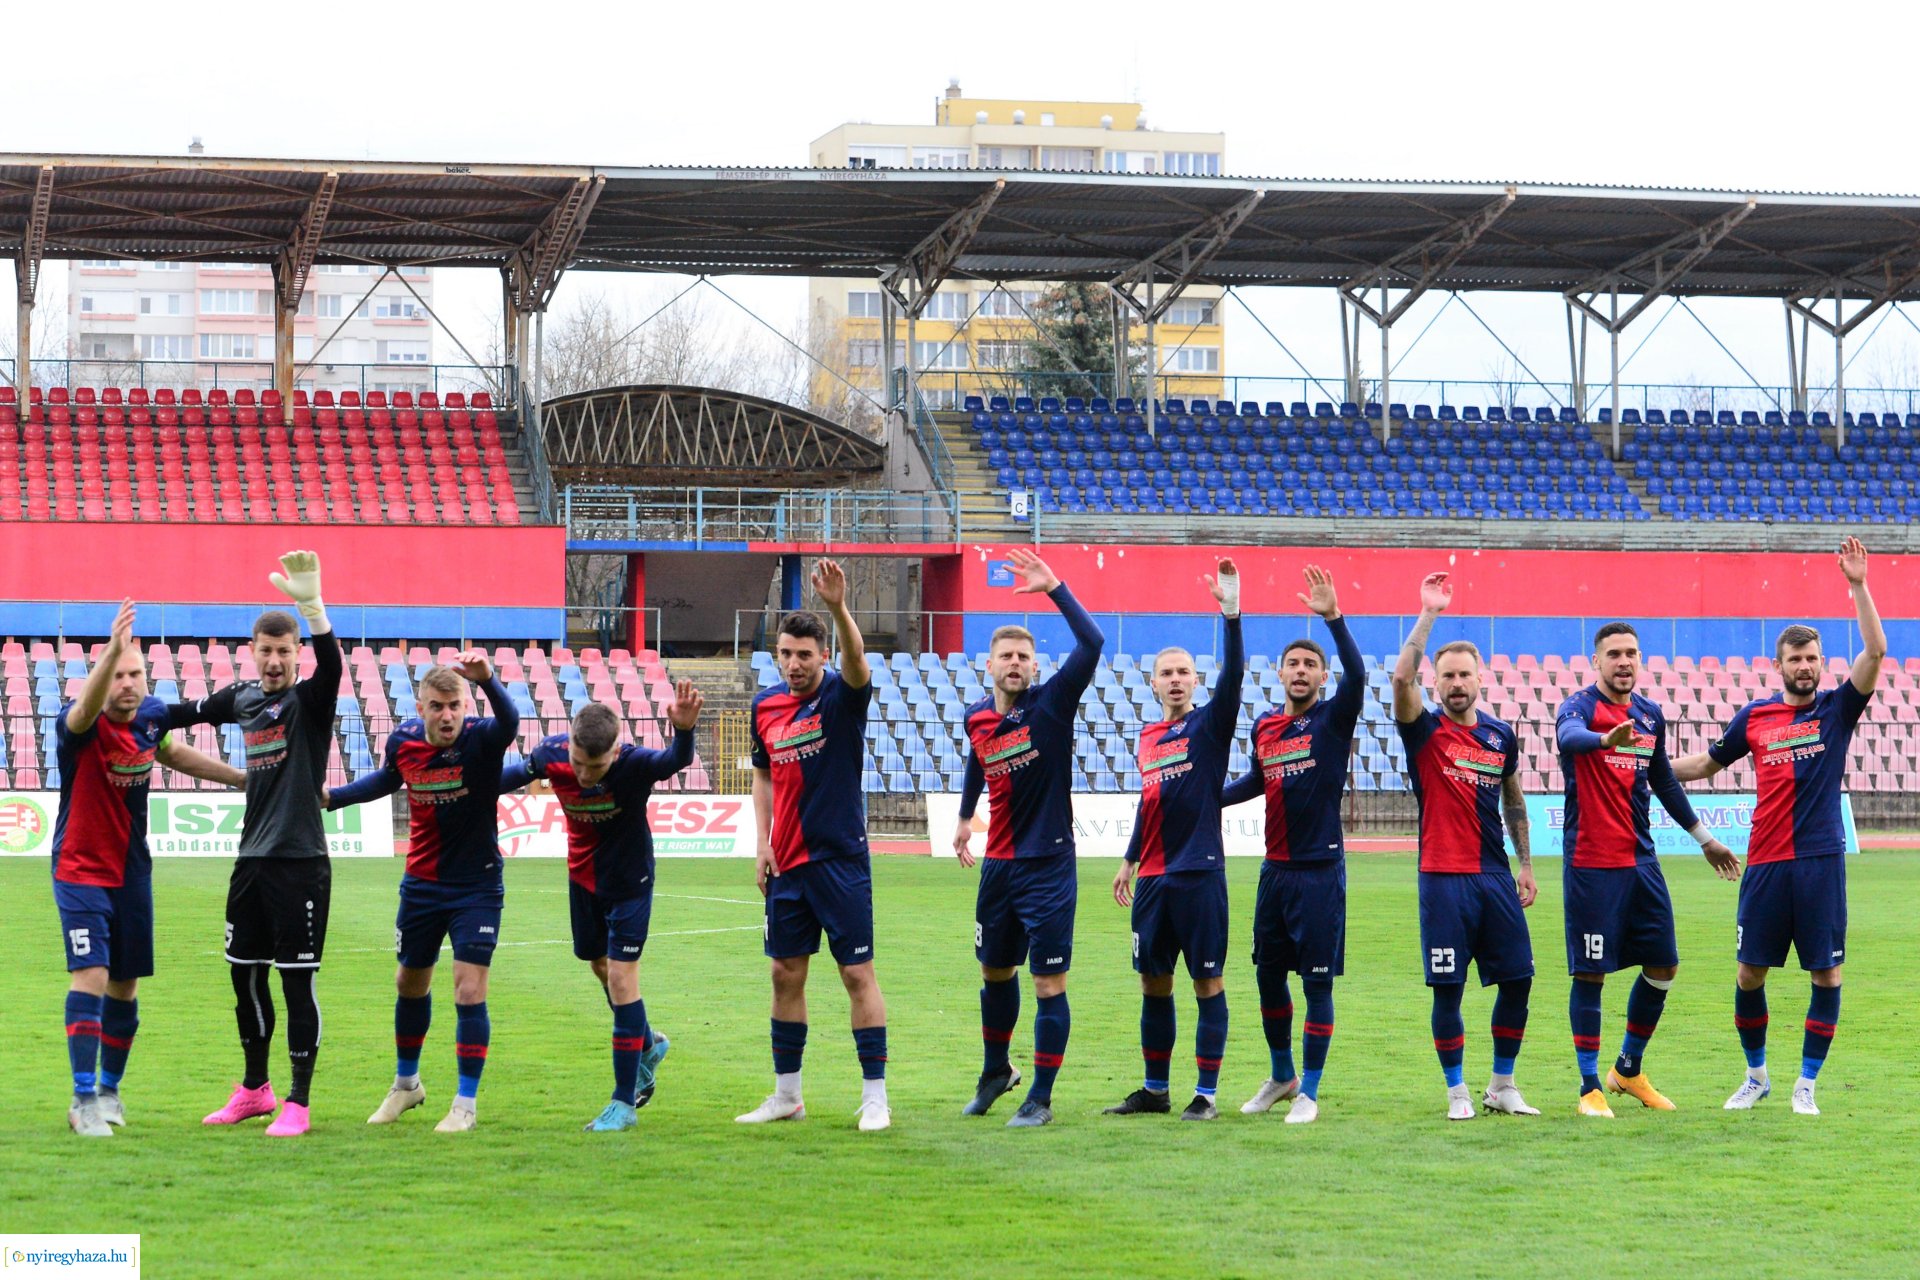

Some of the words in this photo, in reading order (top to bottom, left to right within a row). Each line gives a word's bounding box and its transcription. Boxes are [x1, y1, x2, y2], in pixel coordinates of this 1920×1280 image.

[820, 170, 888, 181] NYÍREGYHÁZA
[1015, 502, 1024, 514] C
[1759, 719, 1821, 746] REVESZ
[157, 839, 241, 852] Labdarú
[668, 841, 702, 850] RIGHT
[705, 841, 731, 850] WAY
[69, 928, 91, 956] 15
[1584, 933, 1603, 960] 19
[1431, 948, 1455, 974] 23
